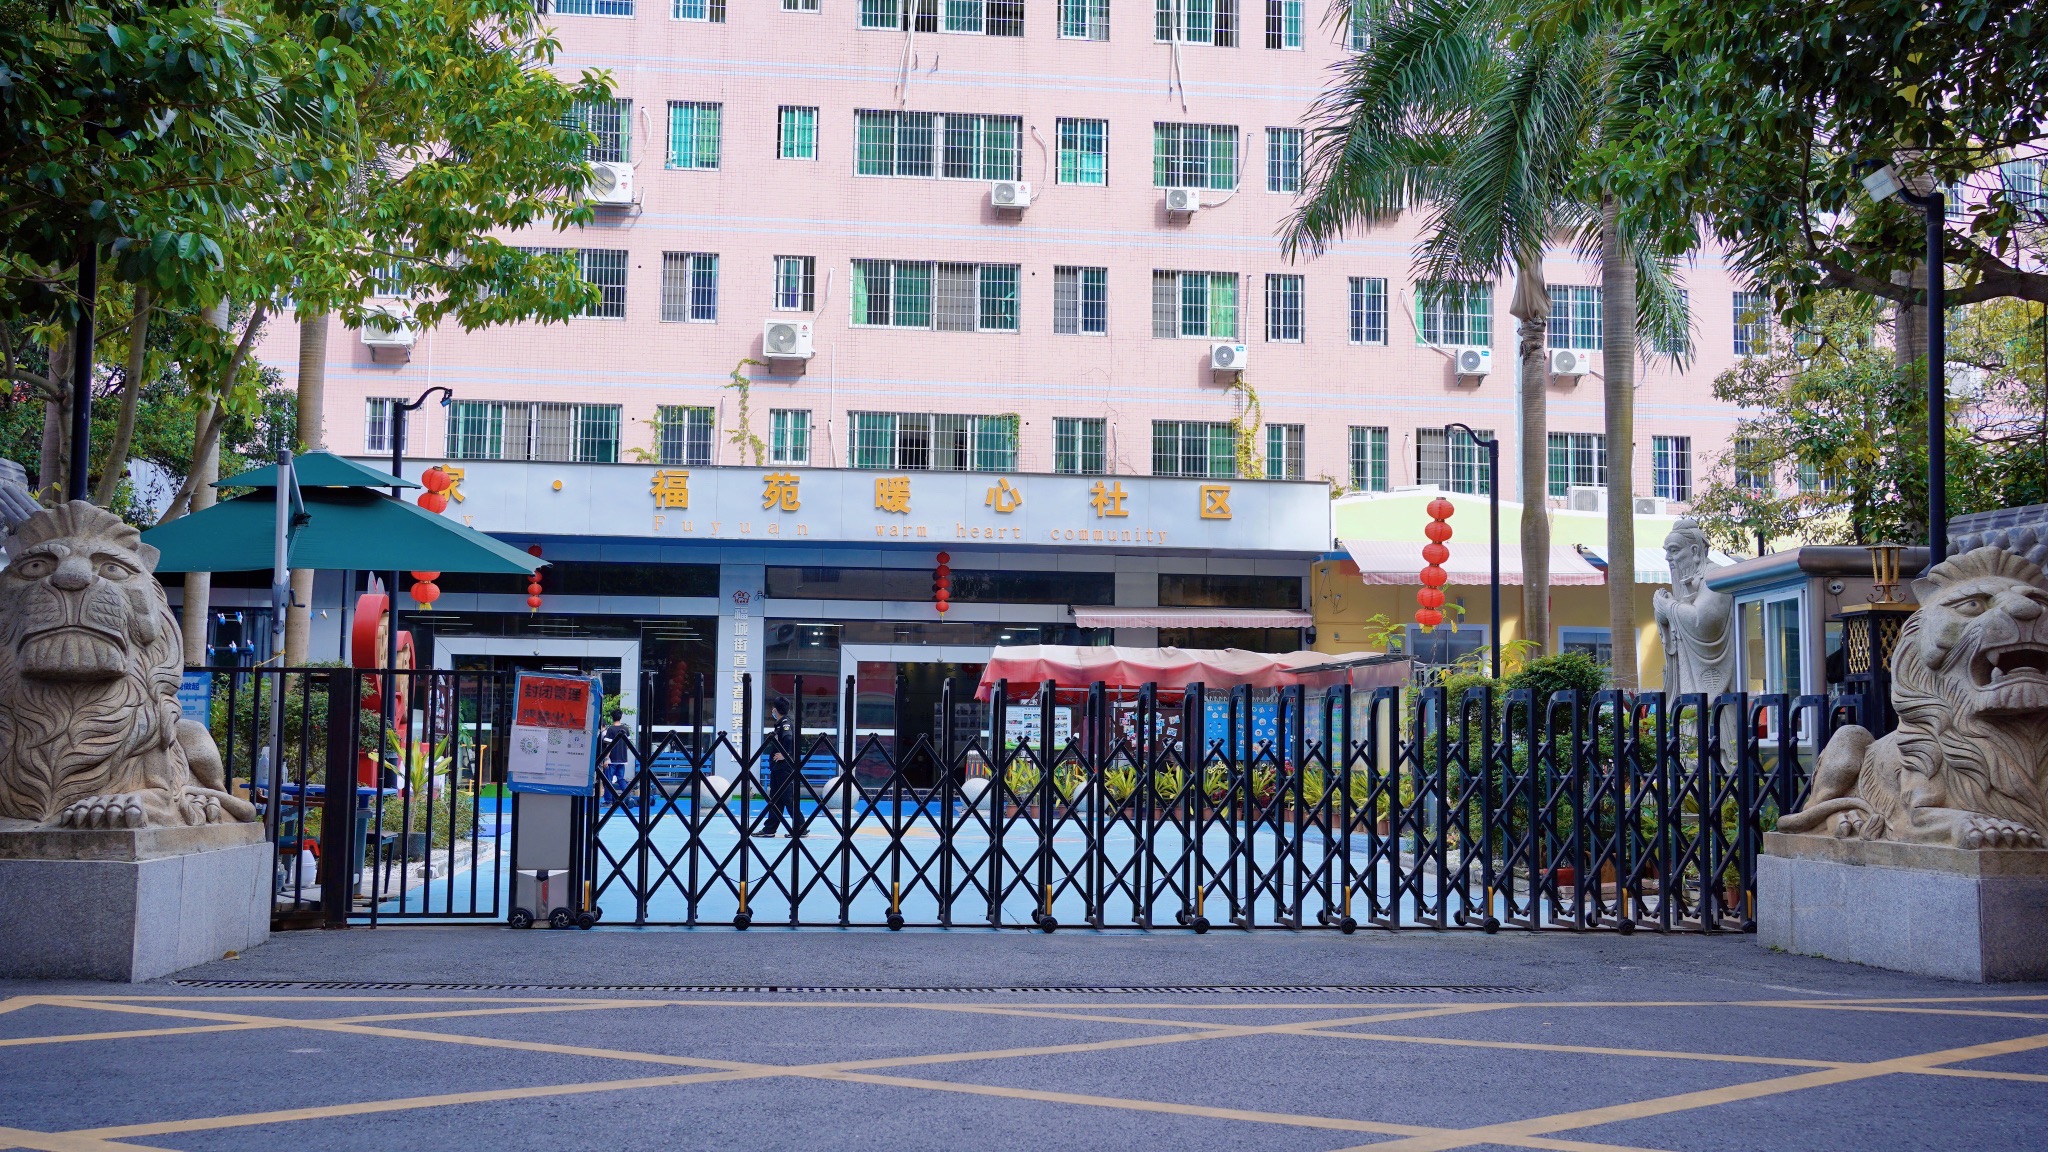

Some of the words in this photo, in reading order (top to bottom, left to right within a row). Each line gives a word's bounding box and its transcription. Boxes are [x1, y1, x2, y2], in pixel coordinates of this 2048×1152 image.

[653, 515, 809, 536] Fuyuan
[875, 524, 927, 538] warm
[956, 523, 1021, 539] heart
[1050, 527, 1168, 544] community
[524, 683, 582, 702] 封闭管理
